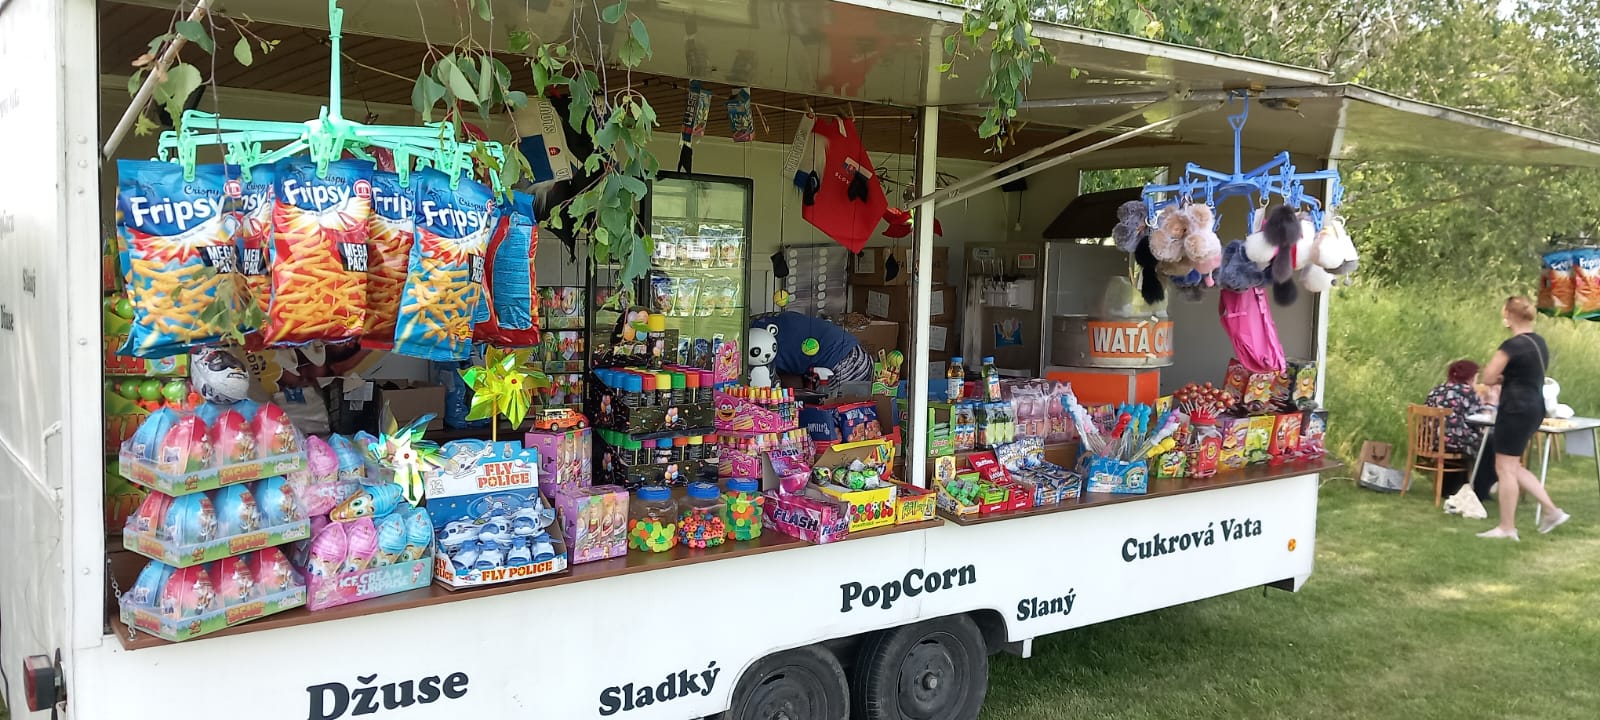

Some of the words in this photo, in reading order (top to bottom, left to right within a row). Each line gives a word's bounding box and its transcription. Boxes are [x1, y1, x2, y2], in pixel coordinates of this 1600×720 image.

[283, 179, 350, 212] Fripsy
[130, 196, 225, 230] Fripsy
[422, 200, 488, 235] Fripsy
[344, 243, 368, 257] MEGA
[348, 256, 368, 271] PACK
[477, 473, 530, 489] POLICE
[483, 462, 514, 476] FLY
[774, 508, 819, 531] FLASH
[822, 521, 849, 535] FLASH
[1121, 522, 1215, 563] Cukrová
[1220, 519, 1263, 542] Vata
[339, 577, 358, 588] ICE
[359, 569, 403, 584] CREAM
[481, 569, 507, 581] FLY
[508, 560, 553, 578] POLICE
[840, 564, 977, 612] PopCorn
[1016, 588, 1078, 621] Slaný
[306, 673, 469, 720] Džuse
[599, 661, 721, 716] Sladký
